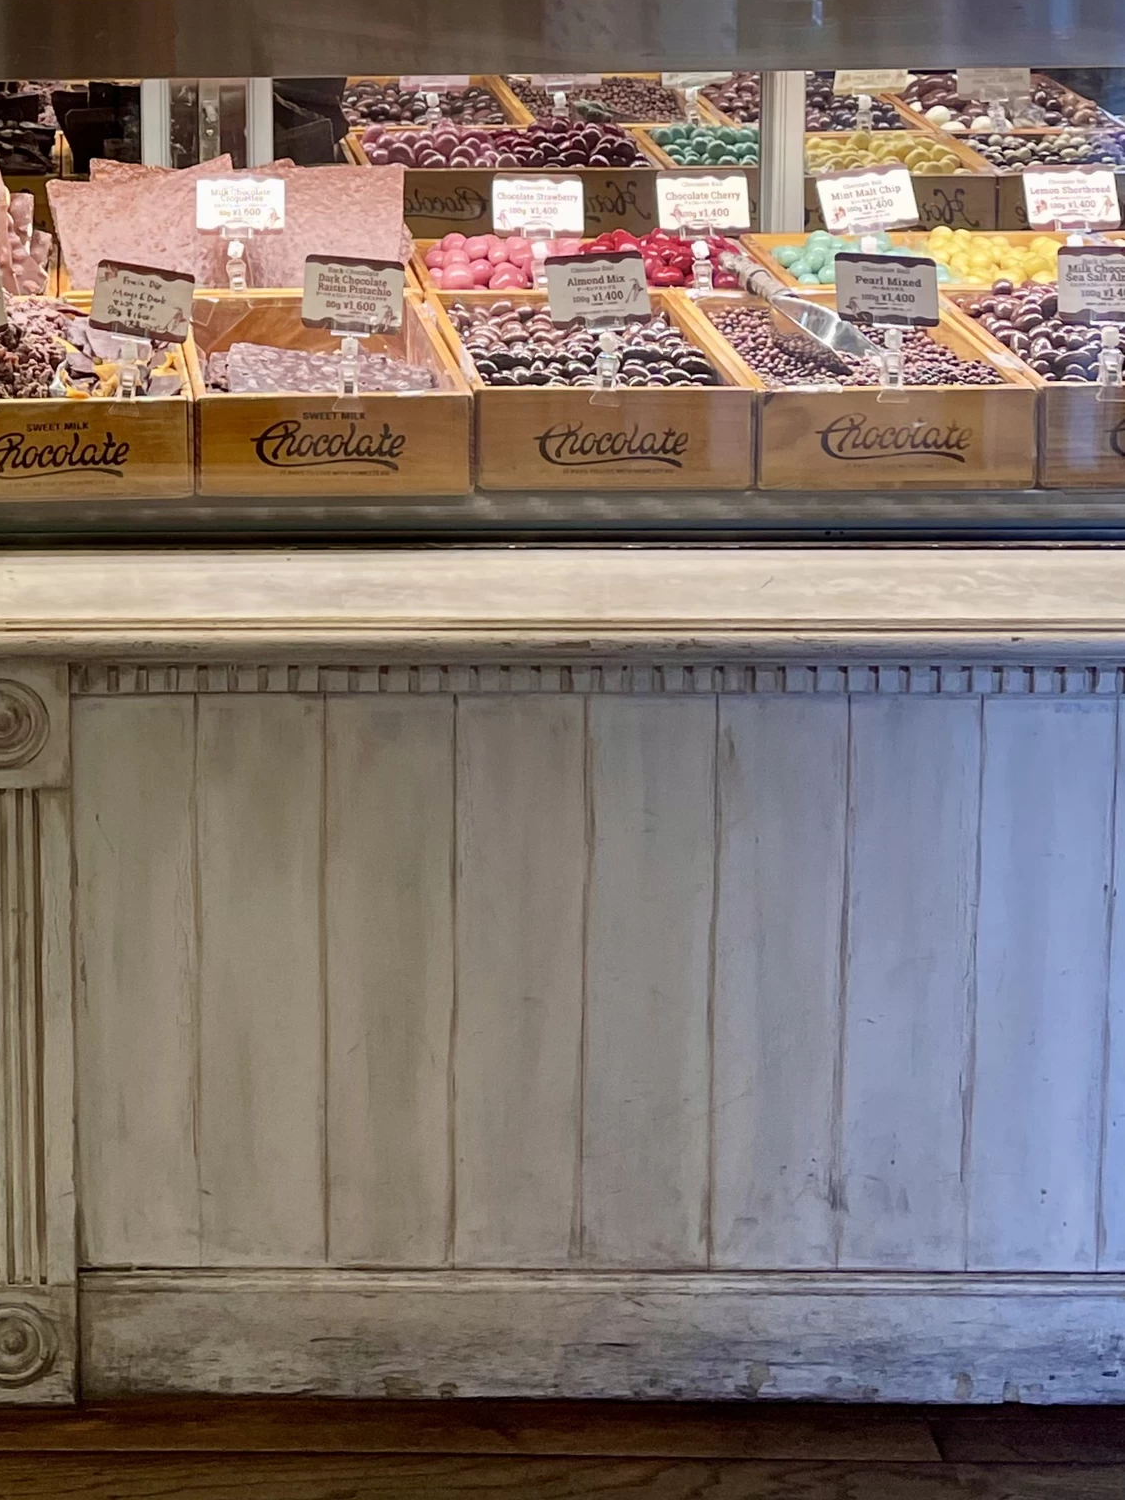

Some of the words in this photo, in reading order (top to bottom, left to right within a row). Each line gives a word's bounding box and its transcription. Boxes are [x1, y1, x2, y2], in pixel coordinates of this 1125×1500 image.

[665, 191, 710, 202] Chocolate
[710, 190, 741, 203] Cherry
[831, 190, 849, 201] Mint
[850, 187, 876, 199] Malt
[878, 184, 902, 198] Chip
[1030, 186, 1059, 195] Lemon
[1061, 185, 1112, 195] Shortbread
[497, 192, 535, 202] Chocolate
[536, 192, 579, 203] Strawberry
[318, 274, 341, 285] Dark
[342, 275, 388, 287] Chocolate
[567, 275, 605, 288] Almond
[607, 273, 625, 284] Mix
[855, 275, 885, 285] Pearl
[887, 277, 922, 288] Mixed
[318, 282, 347, 293] Raisin
[349, 284, 392, 297] Pistachio
[25, 423, 61, 432] SWEET
[64, 422, 90, 431] MILK
[251, 420, 406, 466] Chocolate
[533, 420, 688, 465] Chocolate
[815, 413, 972, 461] Chocolate
